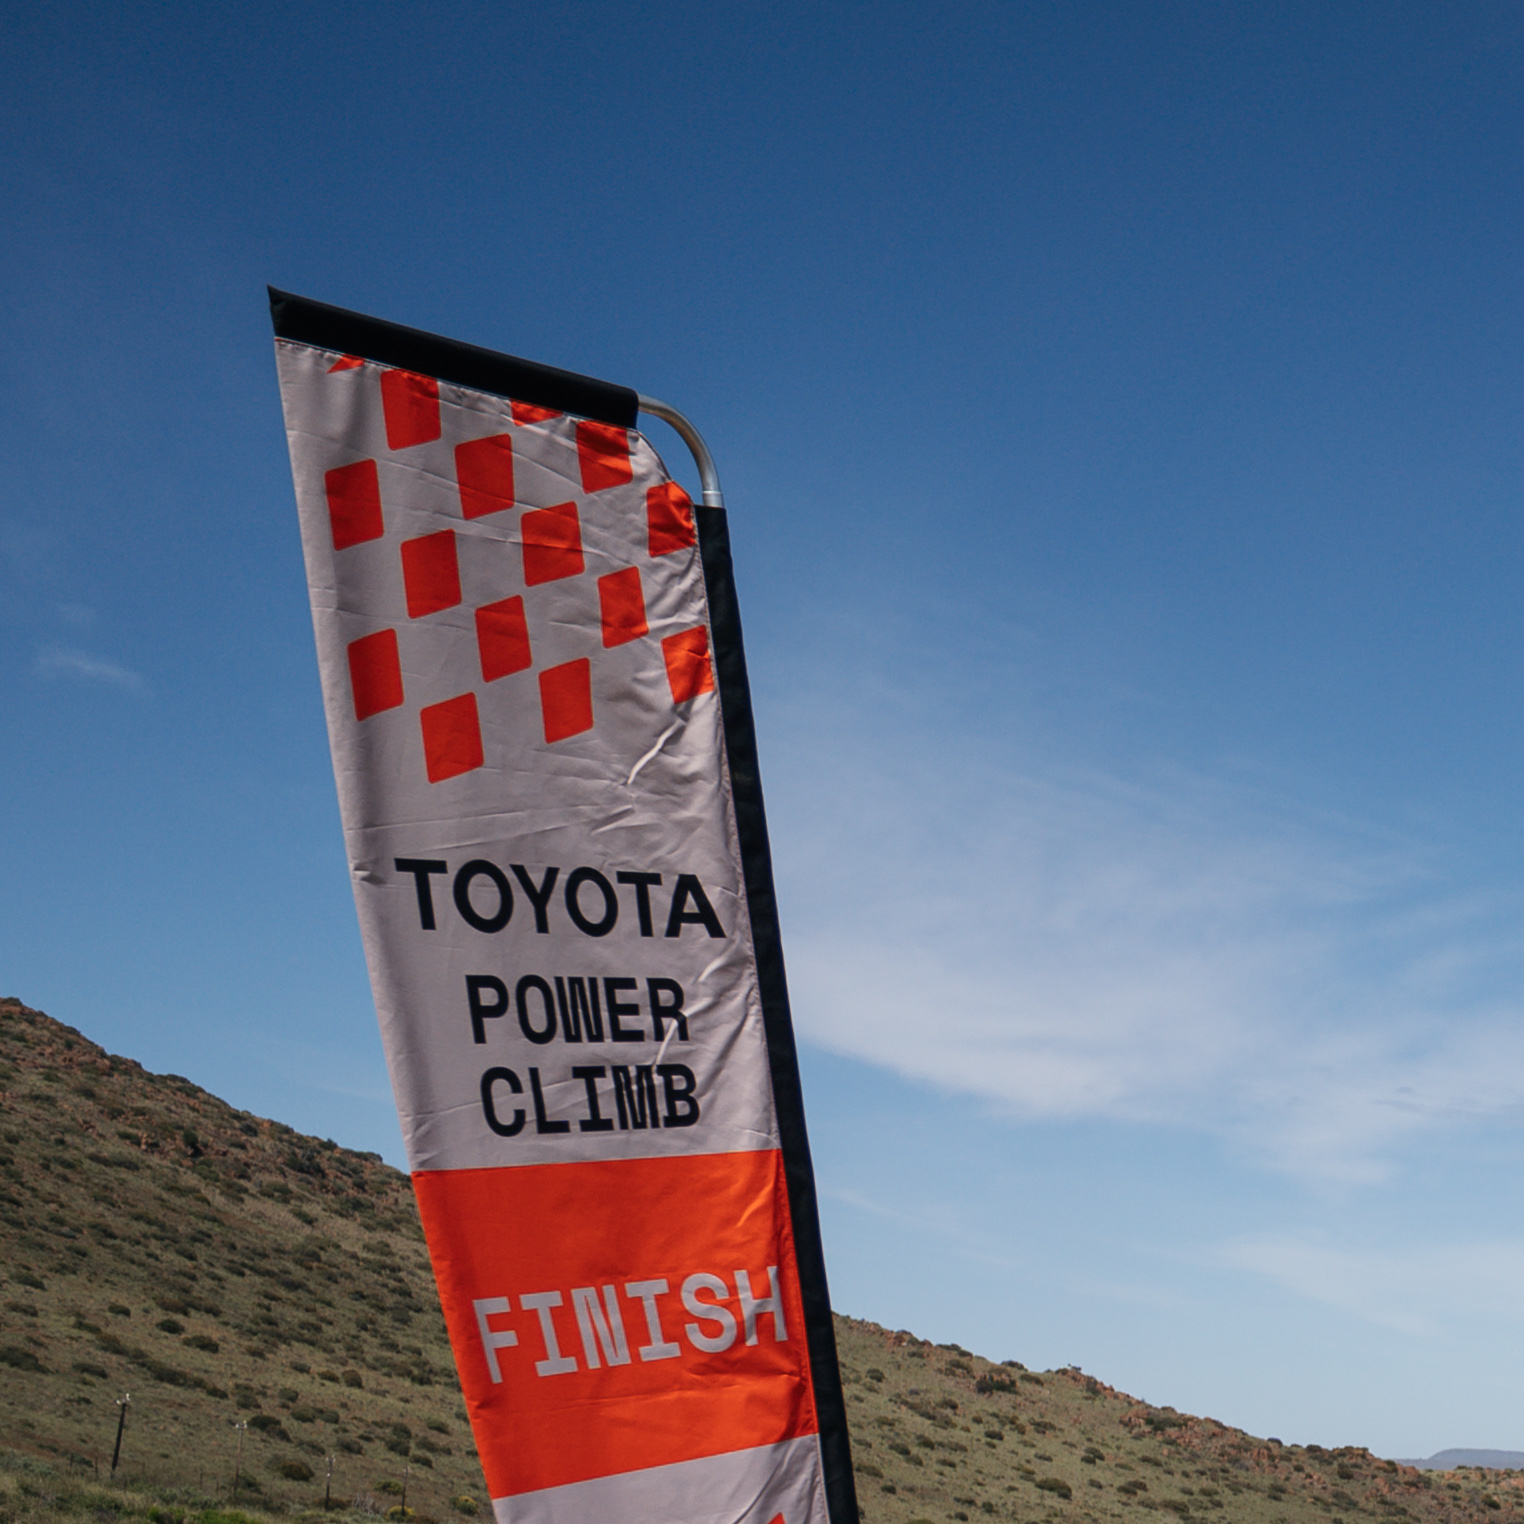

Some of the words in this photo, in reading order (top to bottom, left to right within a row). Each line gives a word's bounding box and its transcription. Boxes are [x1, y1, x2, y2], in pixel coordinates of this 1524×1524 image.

[394, 857, 727, 939] TOYOTA
[464, 974, 689, 1045] POWER
[479, 1062, 701, 1138] CLIMB
[472, 1265, 789, 1385] FINISH
